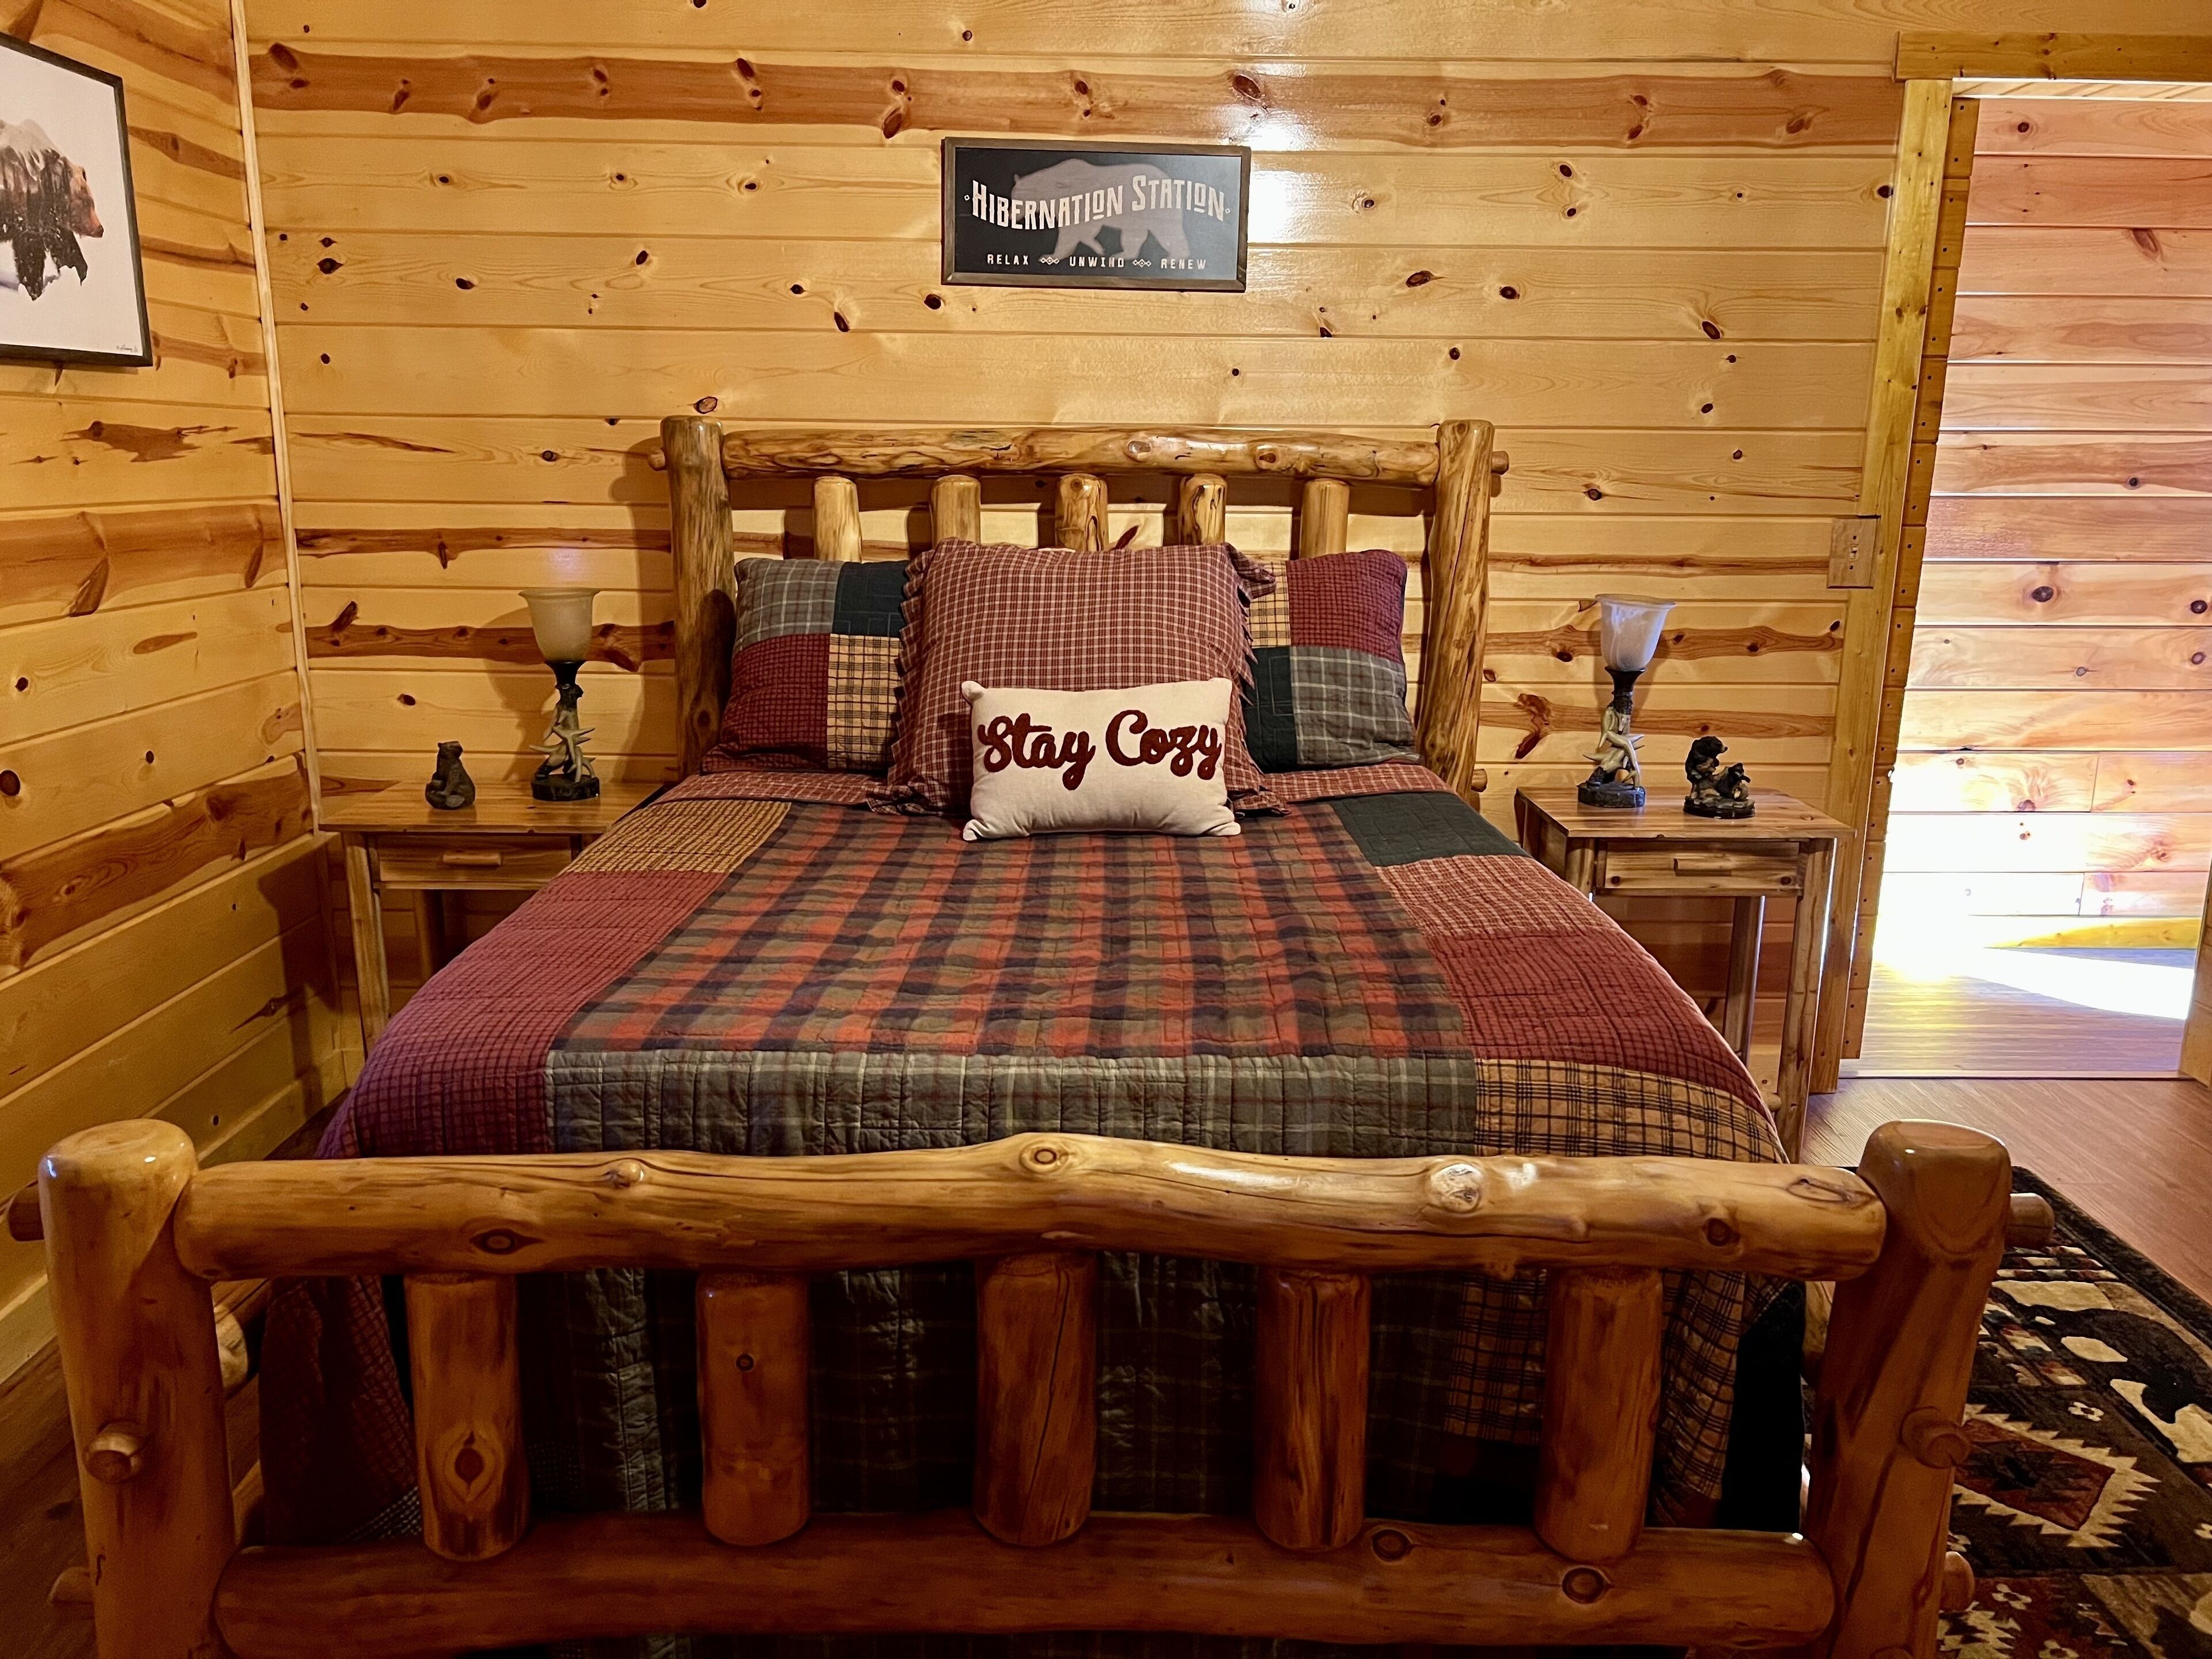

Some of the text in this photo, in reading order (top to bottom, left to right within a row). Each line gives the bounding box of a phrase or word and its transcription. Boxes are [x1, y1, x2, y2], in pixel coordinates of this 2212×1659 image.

[972, 175, 1225, 230] HIBERNATION STATION
[987, 254, 1207, 270] RELAX UNWIND RENEW
[978, 710, 1222, 791] Stay Cozy
